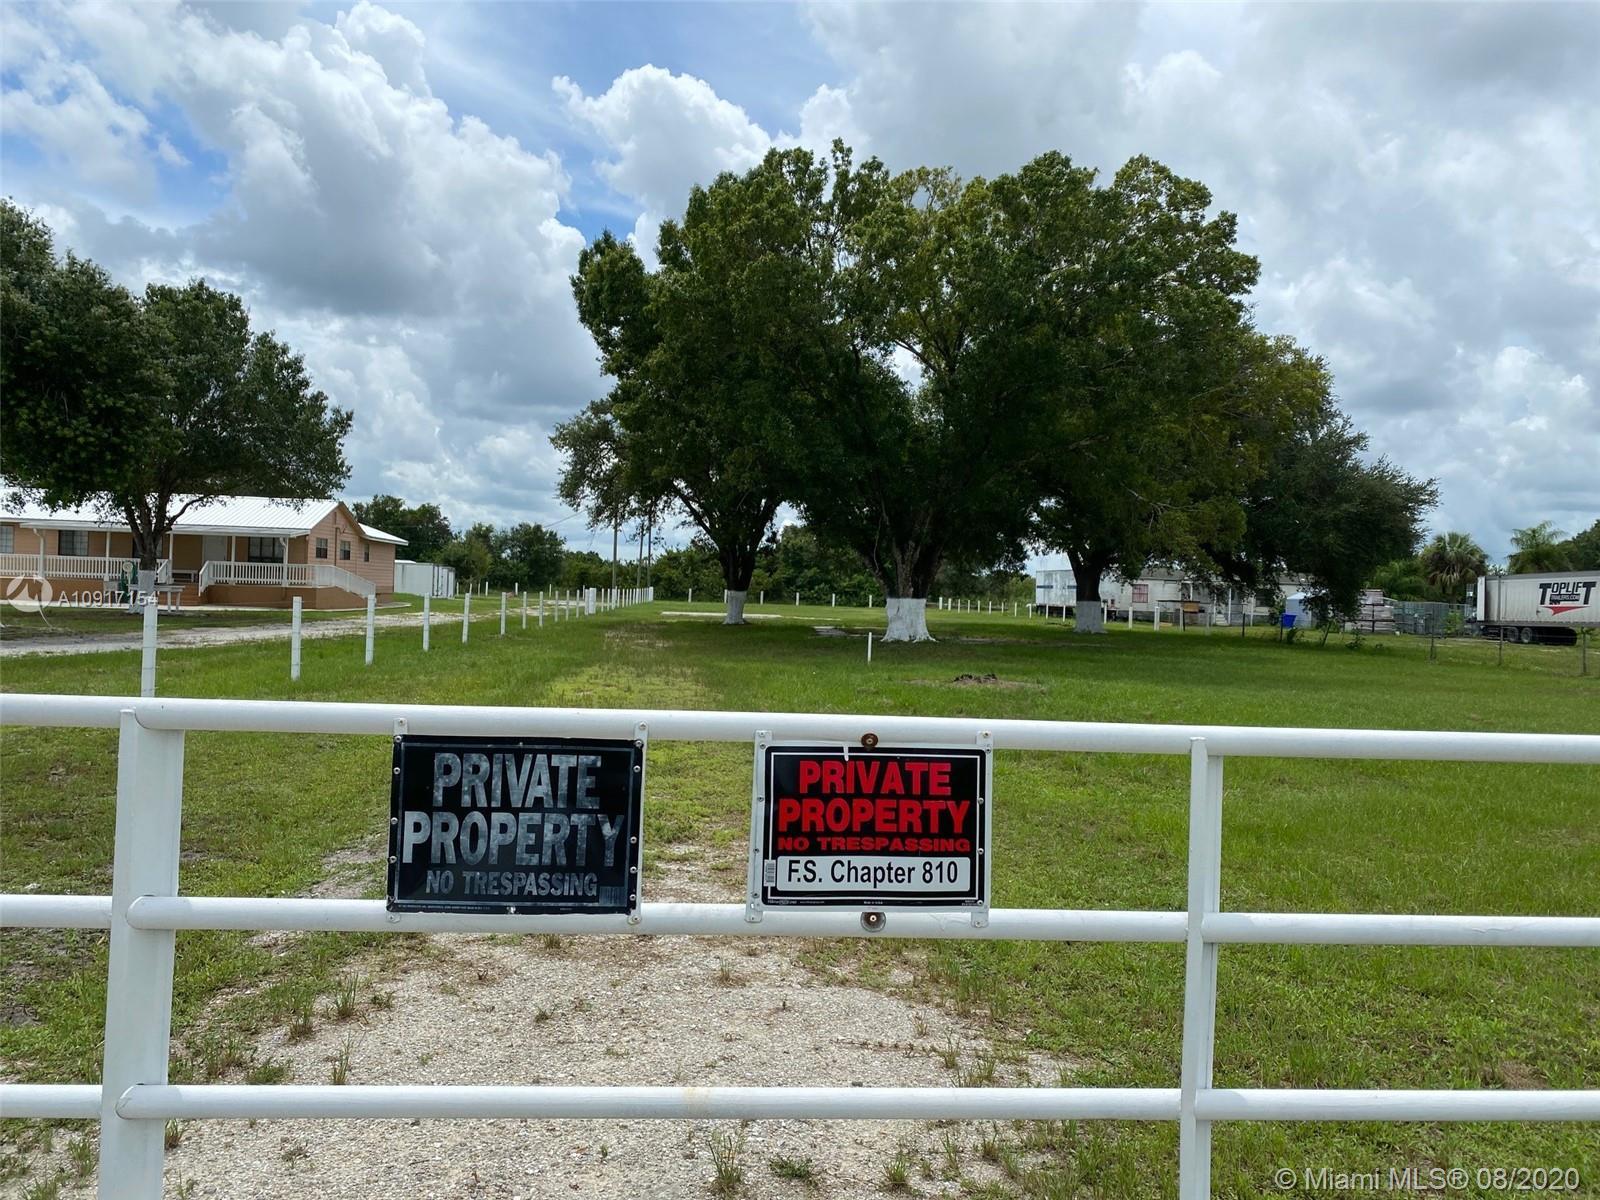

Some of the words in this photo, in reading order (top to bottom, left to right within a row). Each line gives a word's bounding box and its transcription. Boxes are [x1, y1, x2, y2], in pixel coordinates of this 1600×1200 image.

[1539, 581, 1597, 605] TOPLIFT
[432, 752, 602, 809] PRIVATE
[799, 760, 952, 796] PRIVATE
[777, 797, 971, 834] PROPERTY
[402, 810, 624, 867] PROPERTY
[777, 837, 810, 851] NO
[817, 837, 971, 852] TRESPASSING
[426, 870, 454, 894] NO
[462, 871, 598, 896] TRESPASSING
[787, 859, 823, 884] F.S.
[830, 860, 916, 889] Chapter
[922, 861, 958, 884] 810
